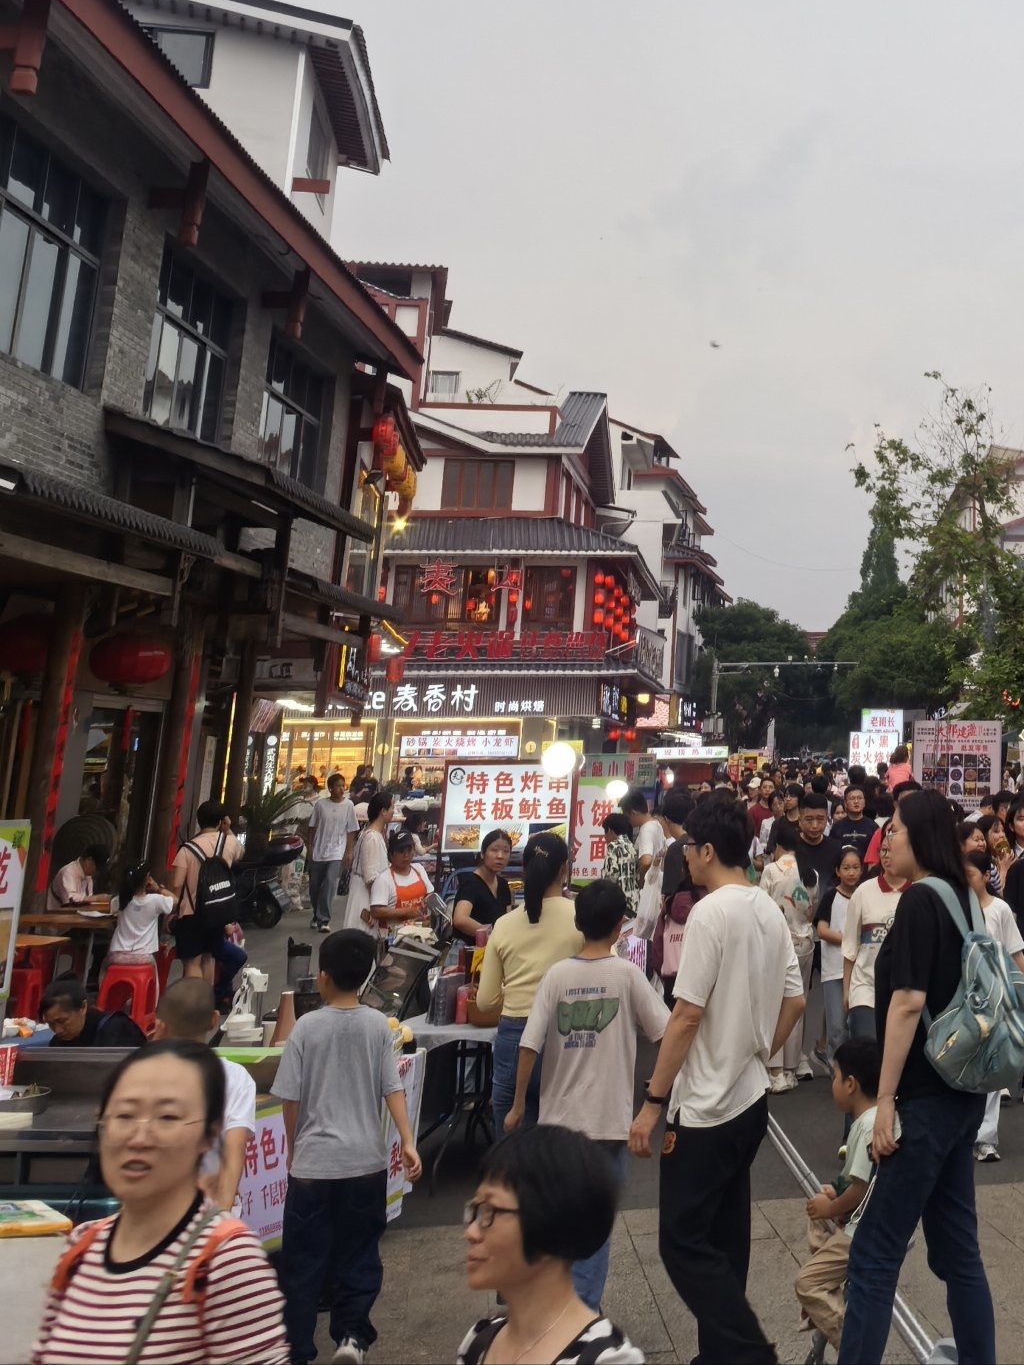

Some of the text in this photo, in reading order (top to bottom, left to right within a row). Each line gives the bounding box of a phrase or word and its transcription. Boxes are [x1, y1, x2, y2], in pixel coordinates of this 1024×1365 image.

[392, 684, 478, 713] 麦香村
[494, 700, 545, 713] 时尚烘焙
[406, 738, 514, 749] 砂锅 炭火烧烤 小龙虾
[466, 771, 569, 794] 特色炸串
[464, 797, 567, 821] 铁板鱿鱼
[208, 880, 231, 893] PUMA
[244, 1127, 286, 1179] 特色
